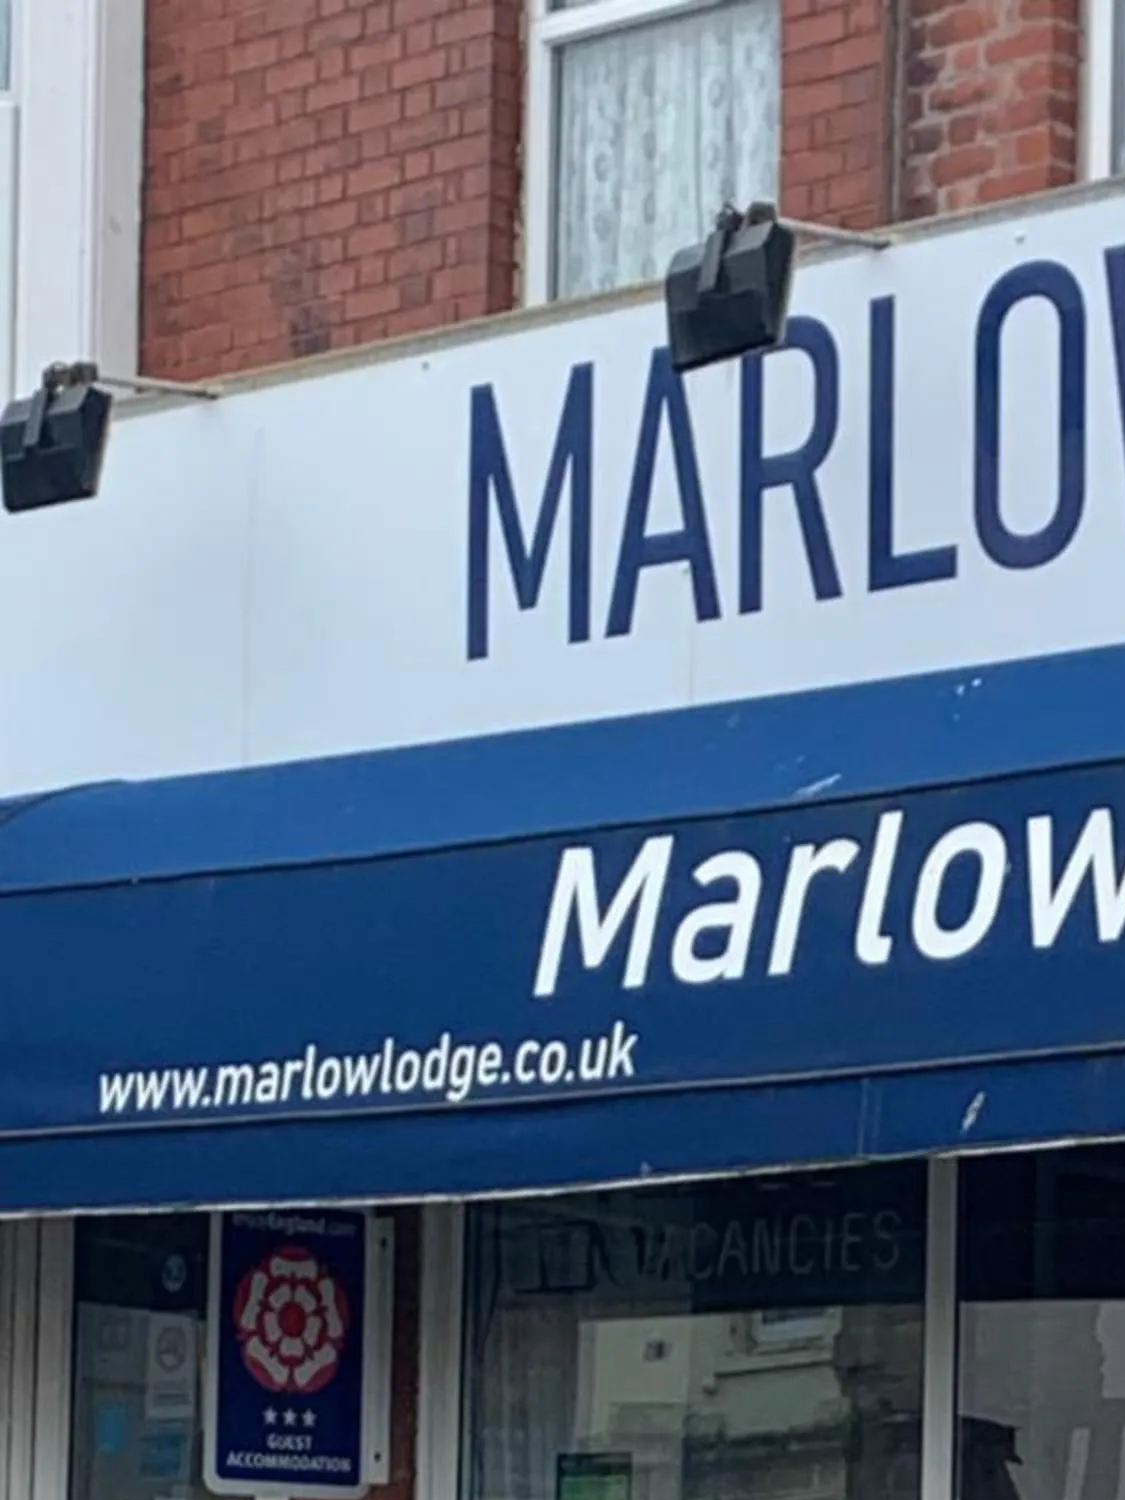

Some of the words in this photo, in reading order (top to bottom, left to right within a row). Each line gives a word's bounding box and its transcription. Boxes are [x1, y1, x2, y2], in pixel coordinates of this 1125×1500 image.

[99, 1020, 638, 1113] www.marlowlodge.co.uk
[265, 1432, 314, 1451] GUEST
[225, 1450, 353, 1473] ACCOMMODATION
